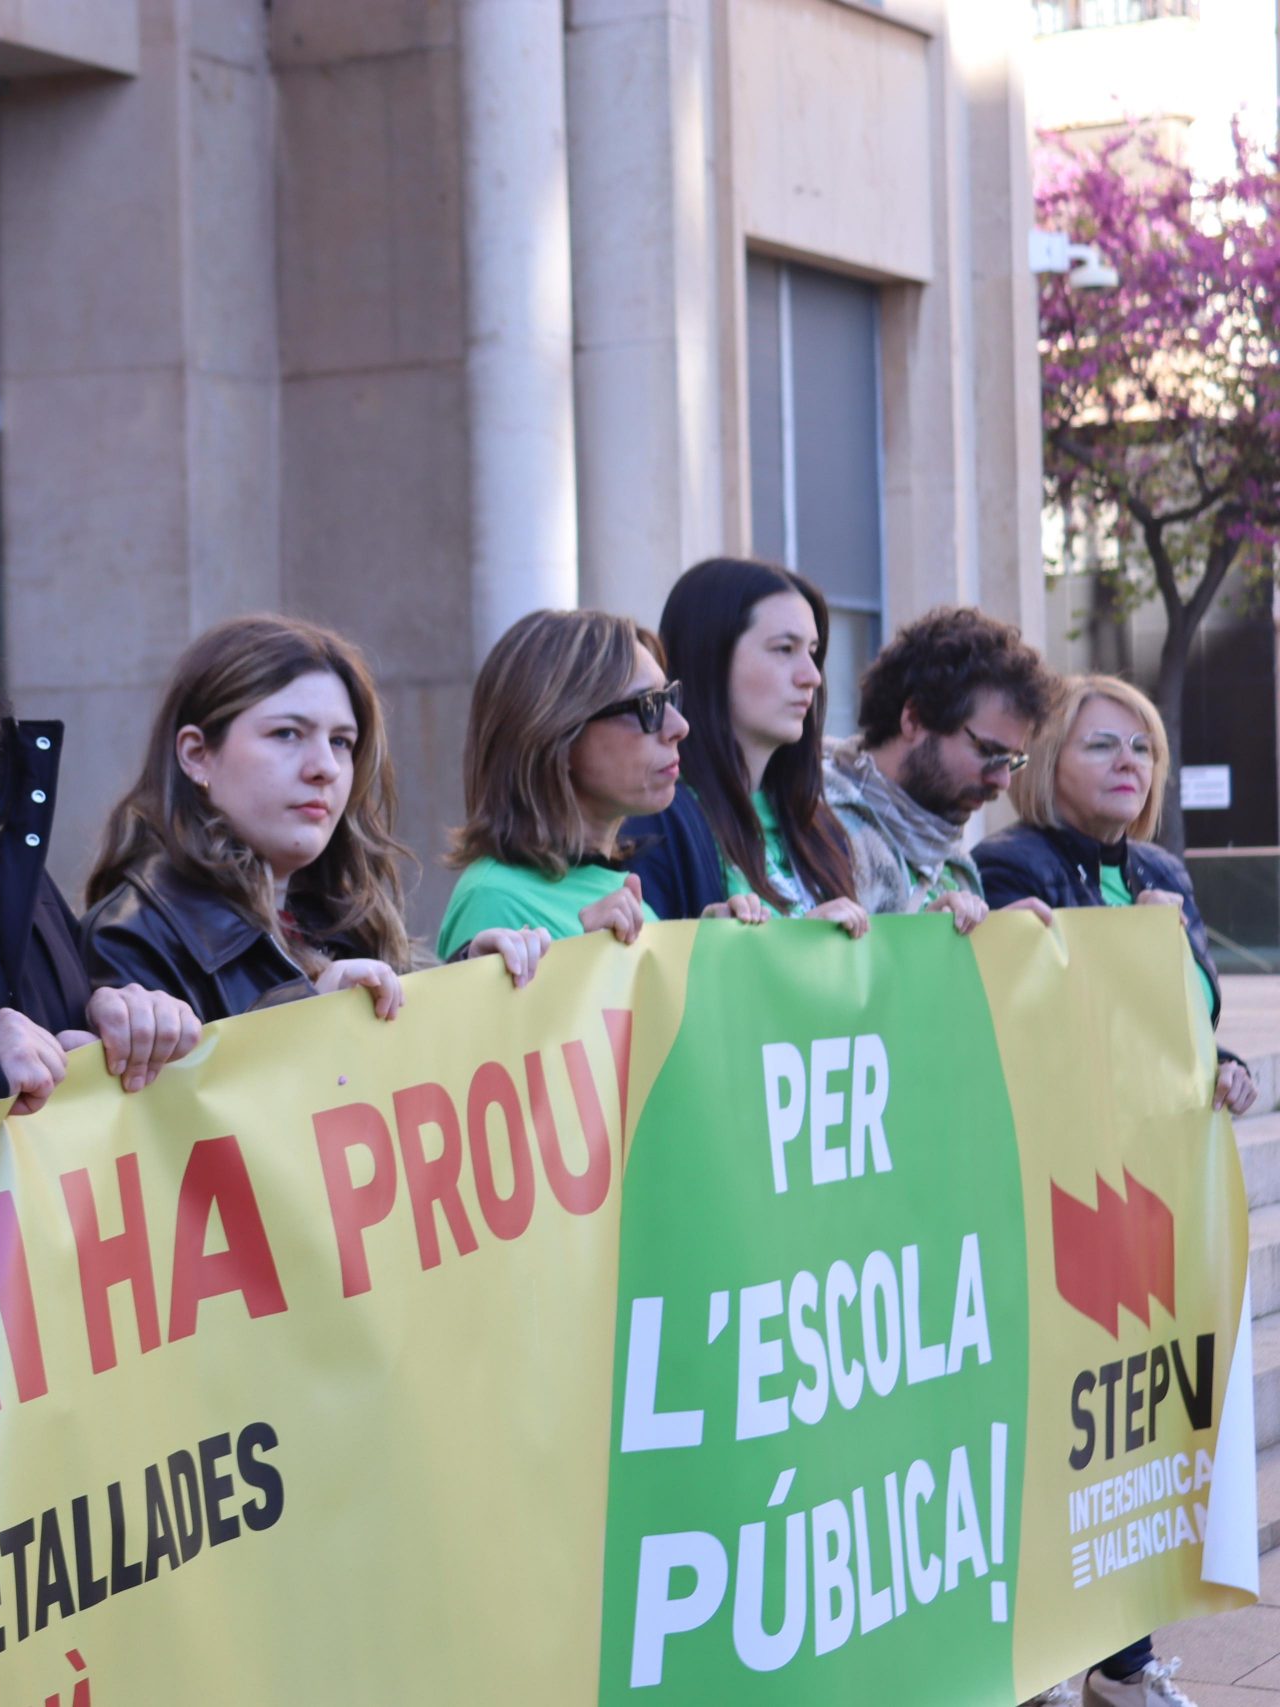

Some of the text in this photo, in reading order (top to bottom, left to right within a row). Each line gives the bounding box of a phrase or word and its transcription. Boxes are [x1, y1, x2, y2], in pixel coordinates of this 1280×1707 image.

[762, 1033, 893, 1194] PER
[59, 1135, 288, 1375] HA
[620, 1233, 992, 1453] L'ESCOLA
[1068, 1332, 1216, 1471] STEPV
[630, 1422, 1008, 1688] PÚBLICA!
